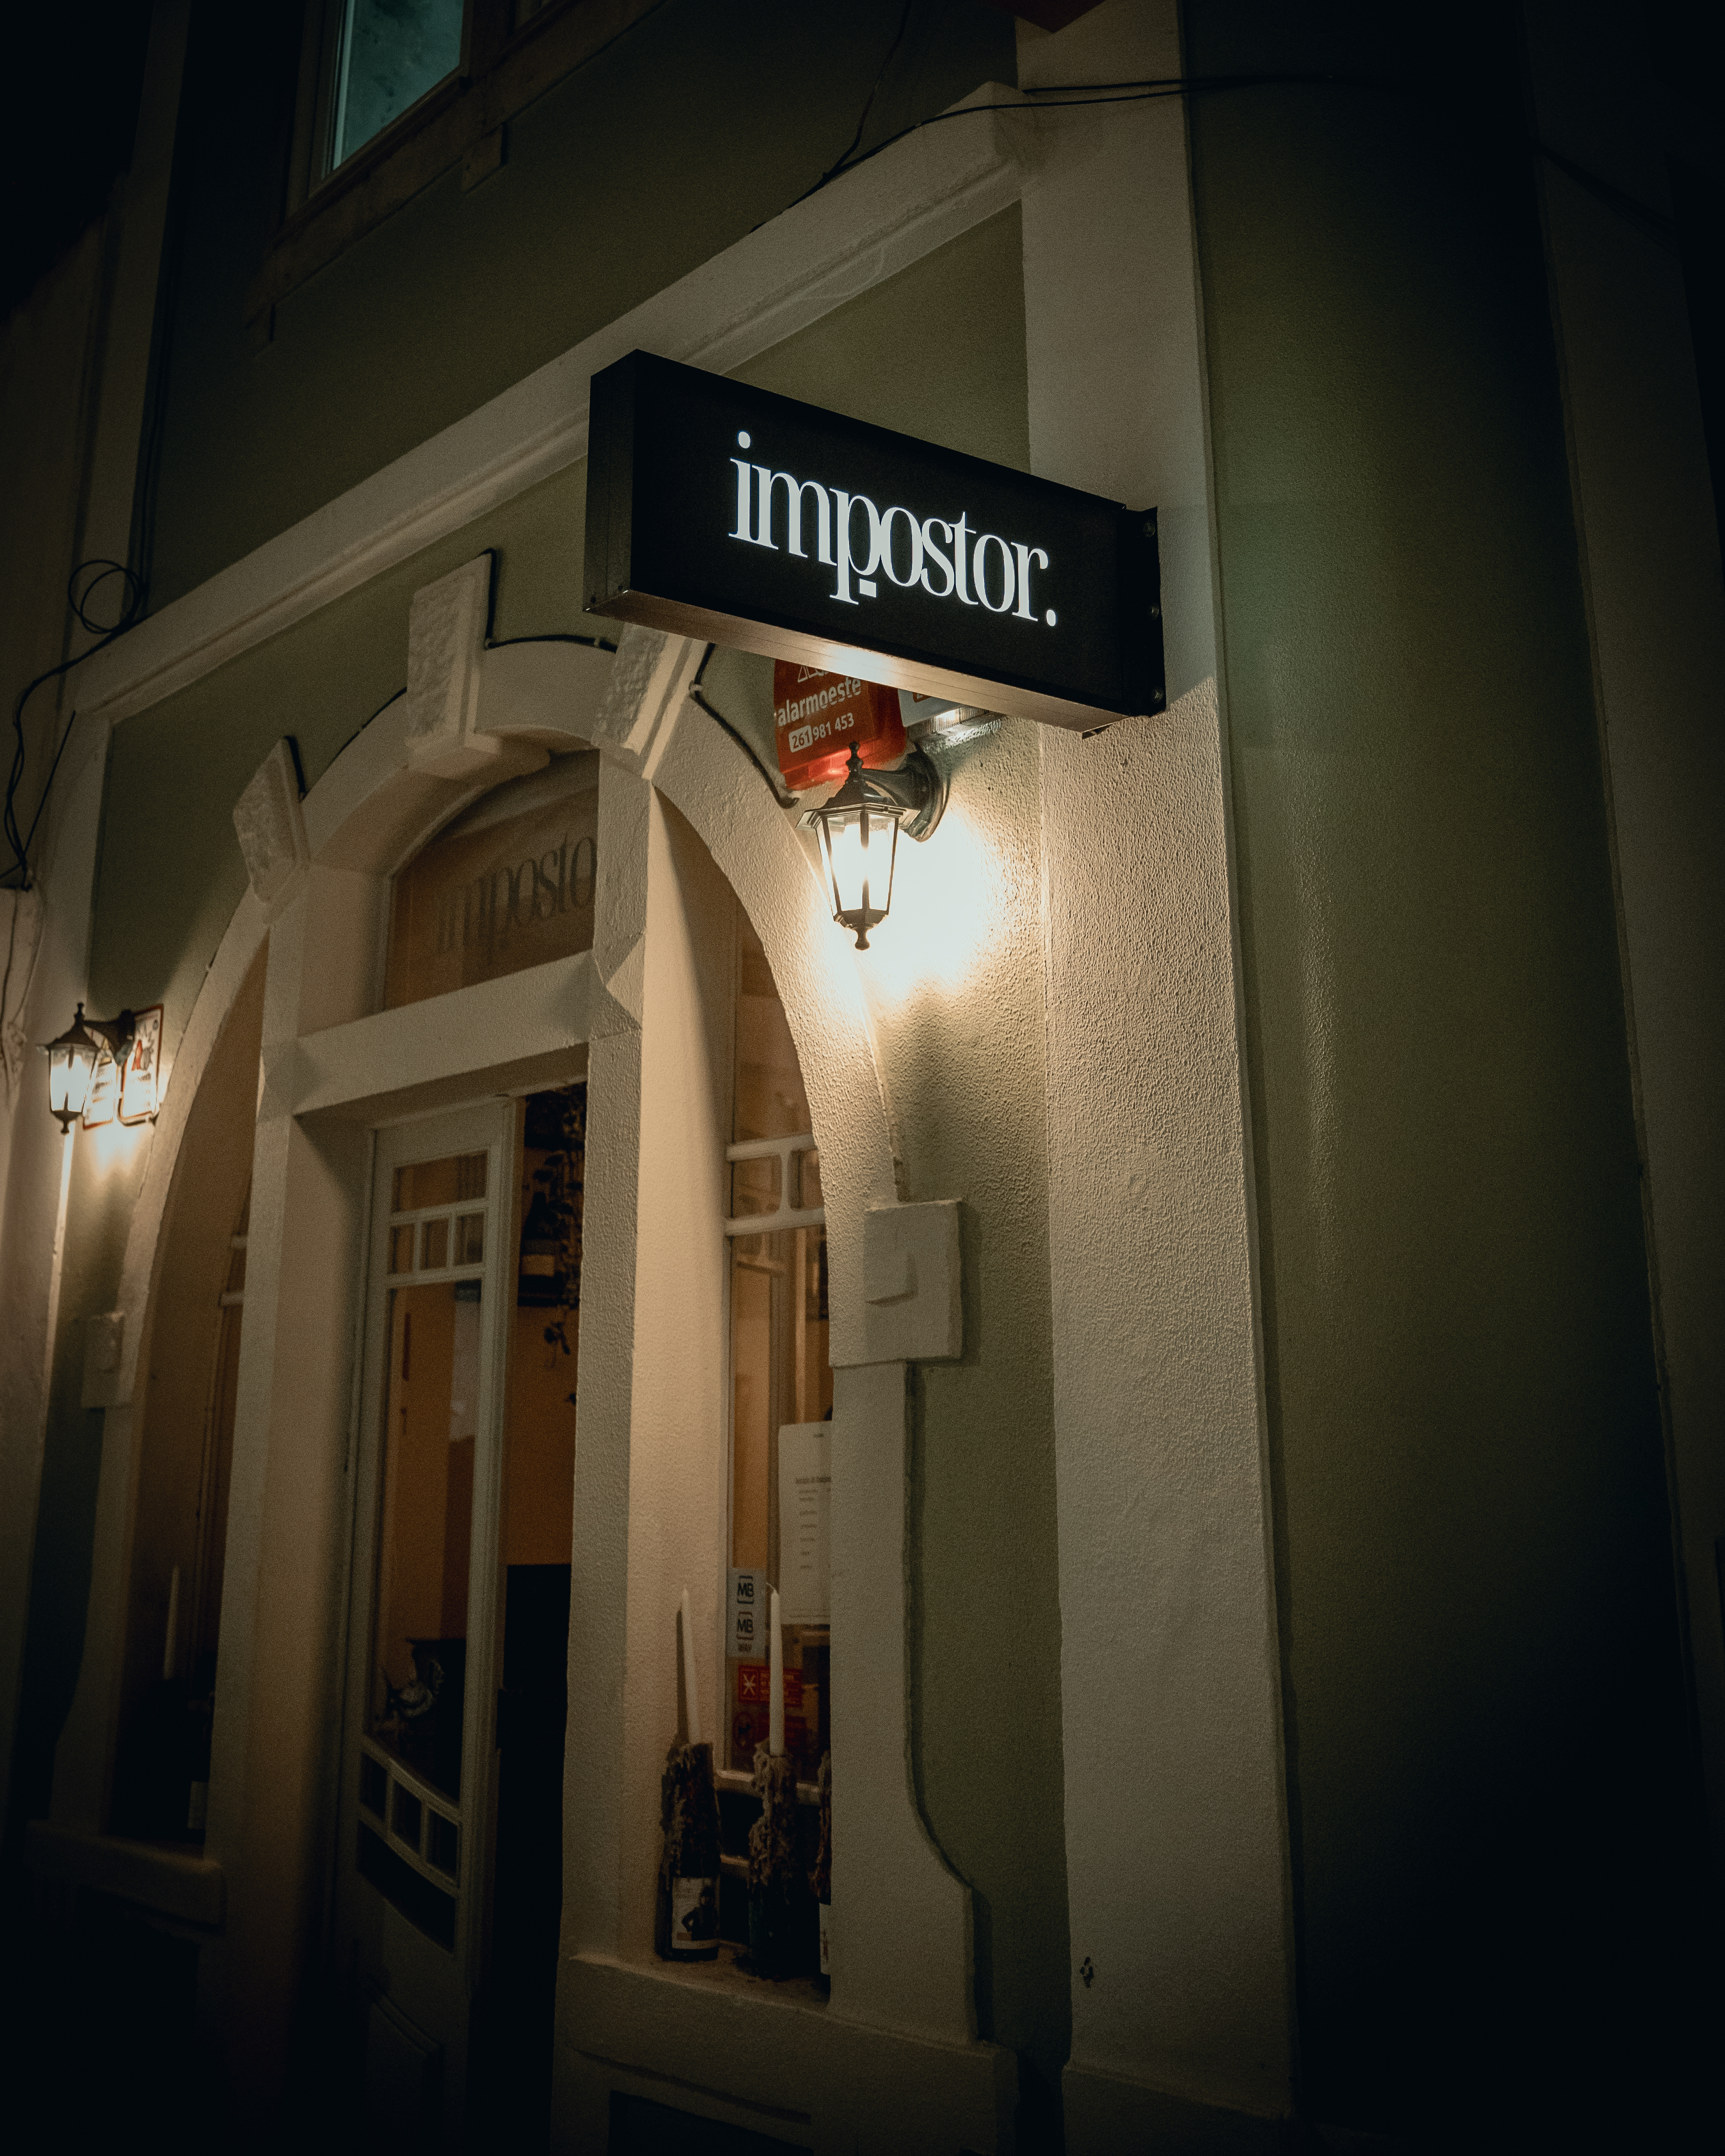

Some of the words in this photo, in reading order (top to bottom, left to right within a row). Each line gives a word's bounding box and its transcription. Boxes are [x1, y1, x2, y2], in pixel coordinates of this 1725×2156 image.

[728, 430, 1057, 627] impostor.
[778, 676, 861, 727] alarmoeste
[792, 730, 811, 750] 261
[812, 721, 832, 741] 981
[834, 712, 854, 732] 453
[737, 1583, 754, 1597] MB
[737, 1619, 754, 1633] MB
